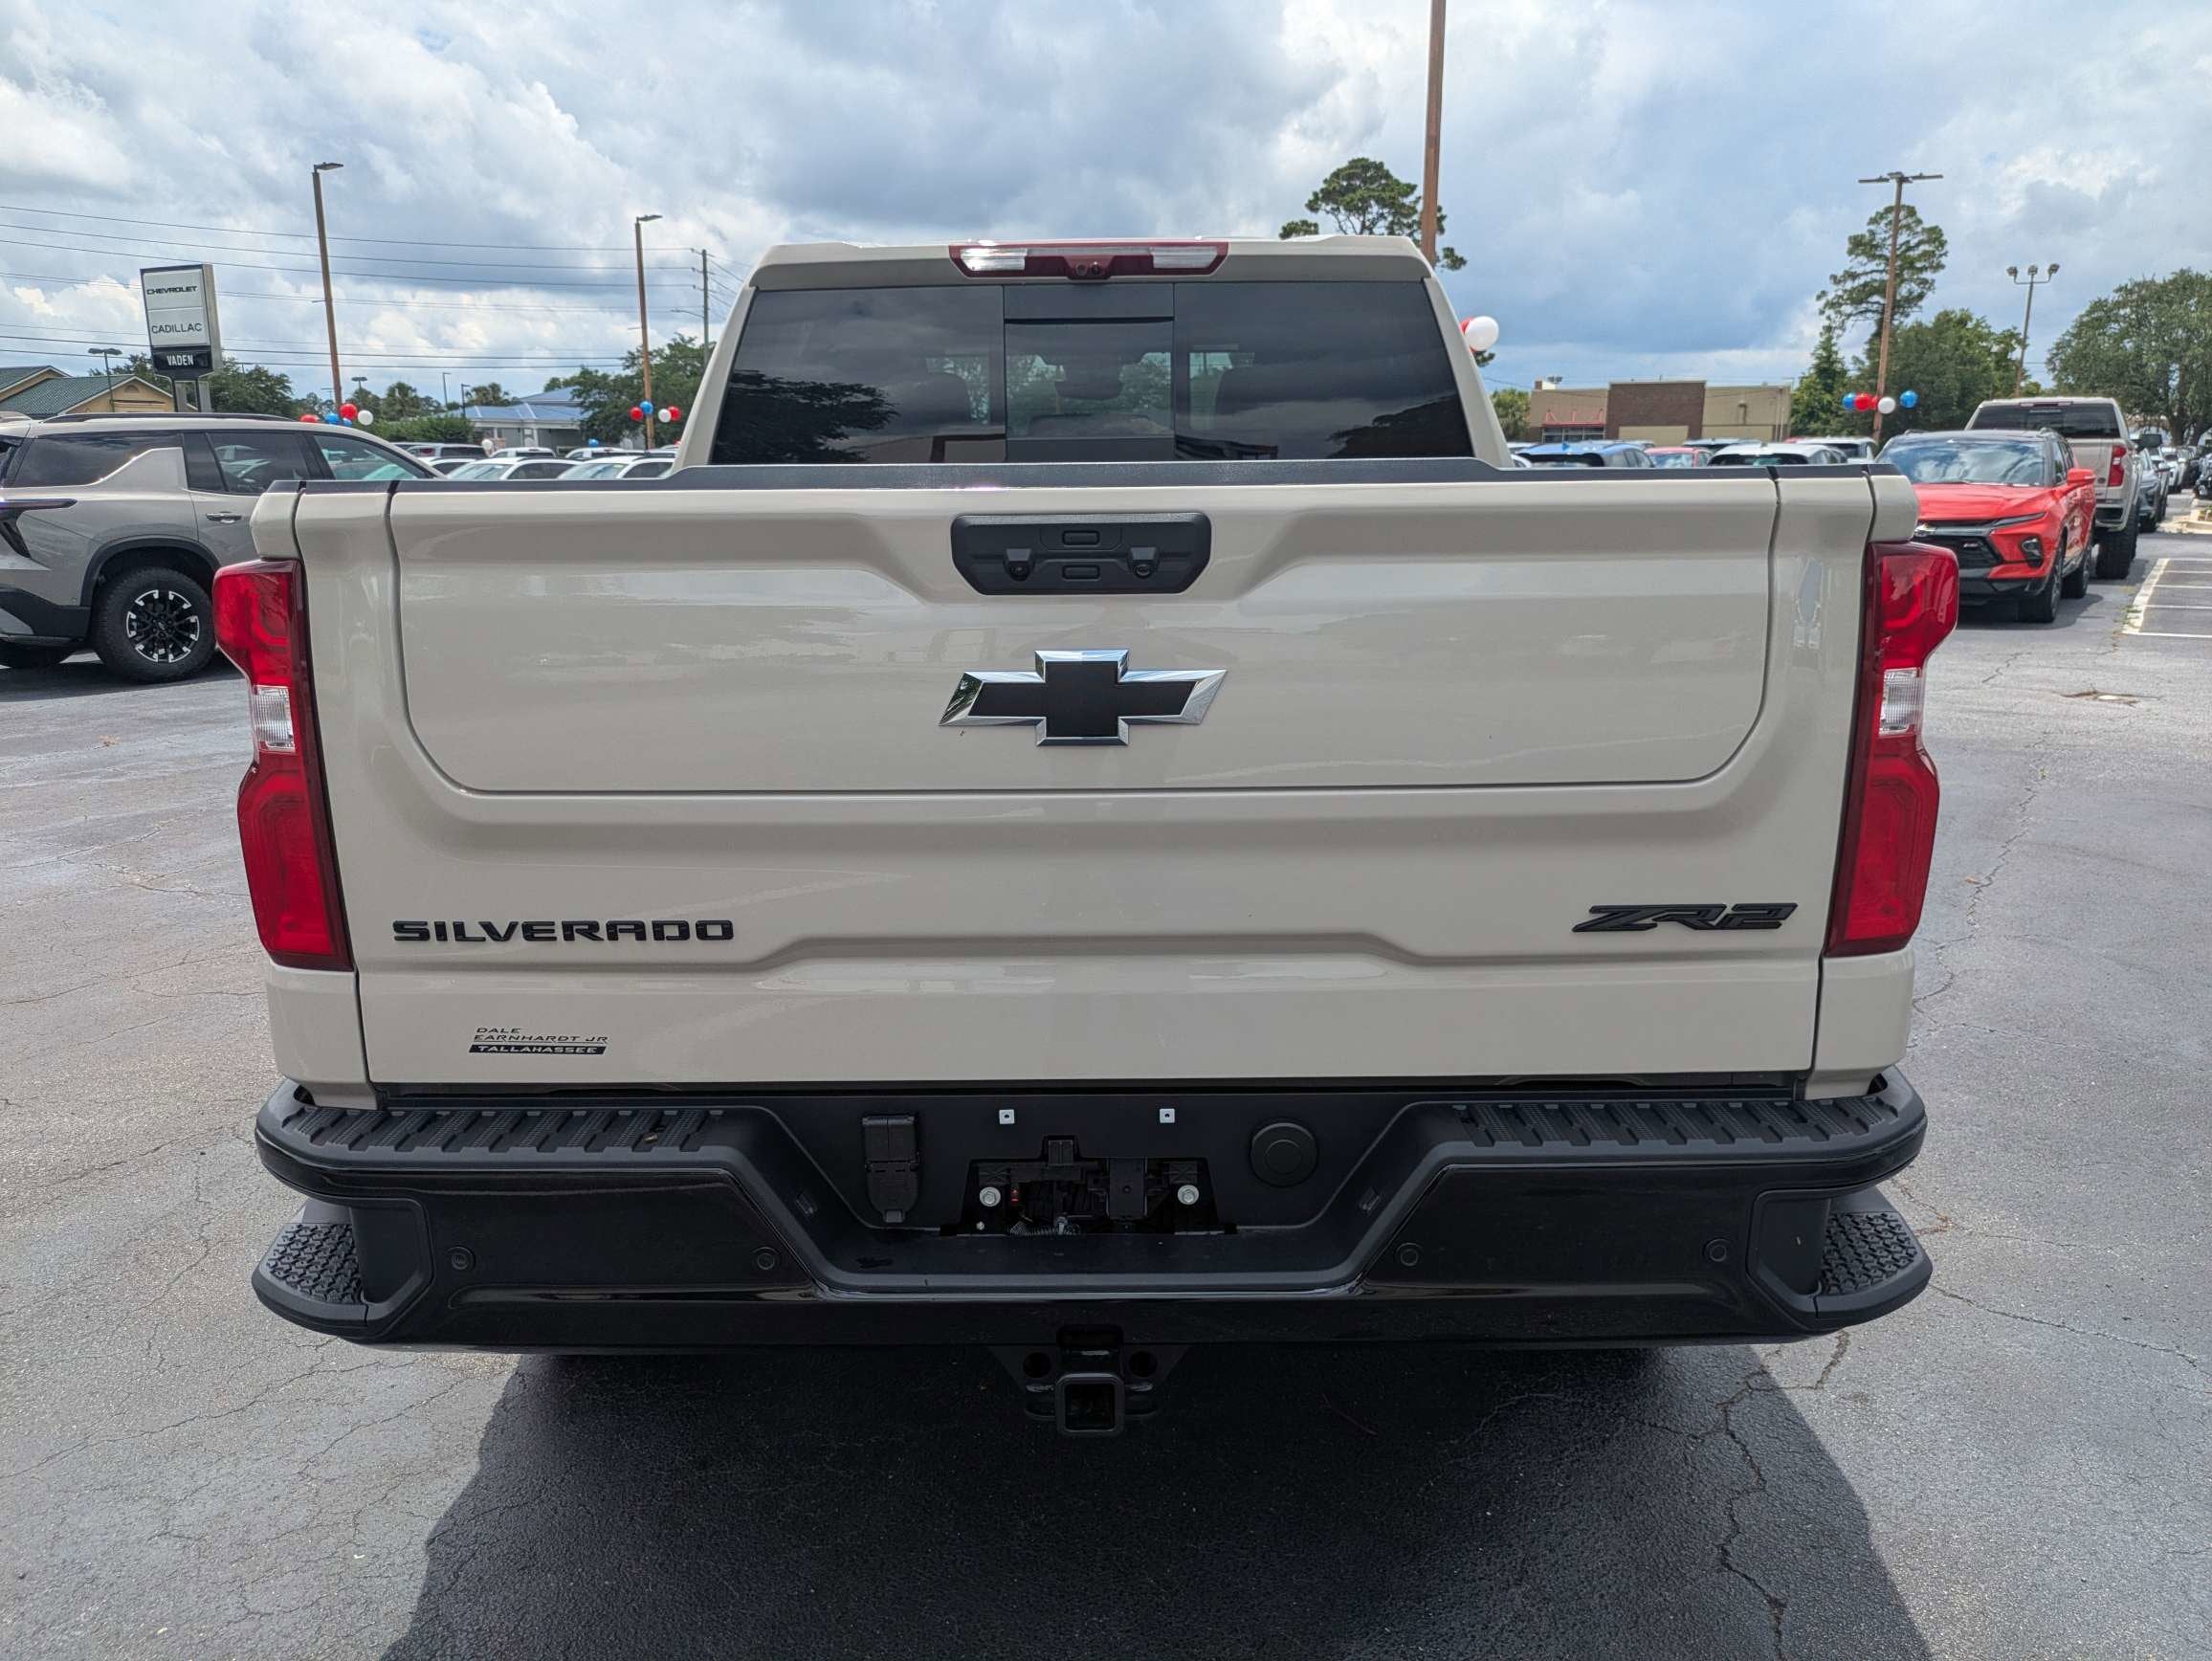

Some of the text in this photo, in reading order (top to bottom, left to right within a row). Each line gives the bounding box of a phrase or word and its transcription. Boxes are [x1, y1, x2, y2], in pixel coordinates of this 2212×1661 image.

[146, 285, 197, 295] CHEVROLET
[151, 322, 203, 334] CADILLAC
[166, 354, 194, 366] VADEN
[1572, 902, 1799, 933] ZR2
[392, 919, 735, 942] SILVERADO
[474, 1034, 580, 1043] EARNHARDT
[477, 1045, 598, 1053] TALLAHASSEE
